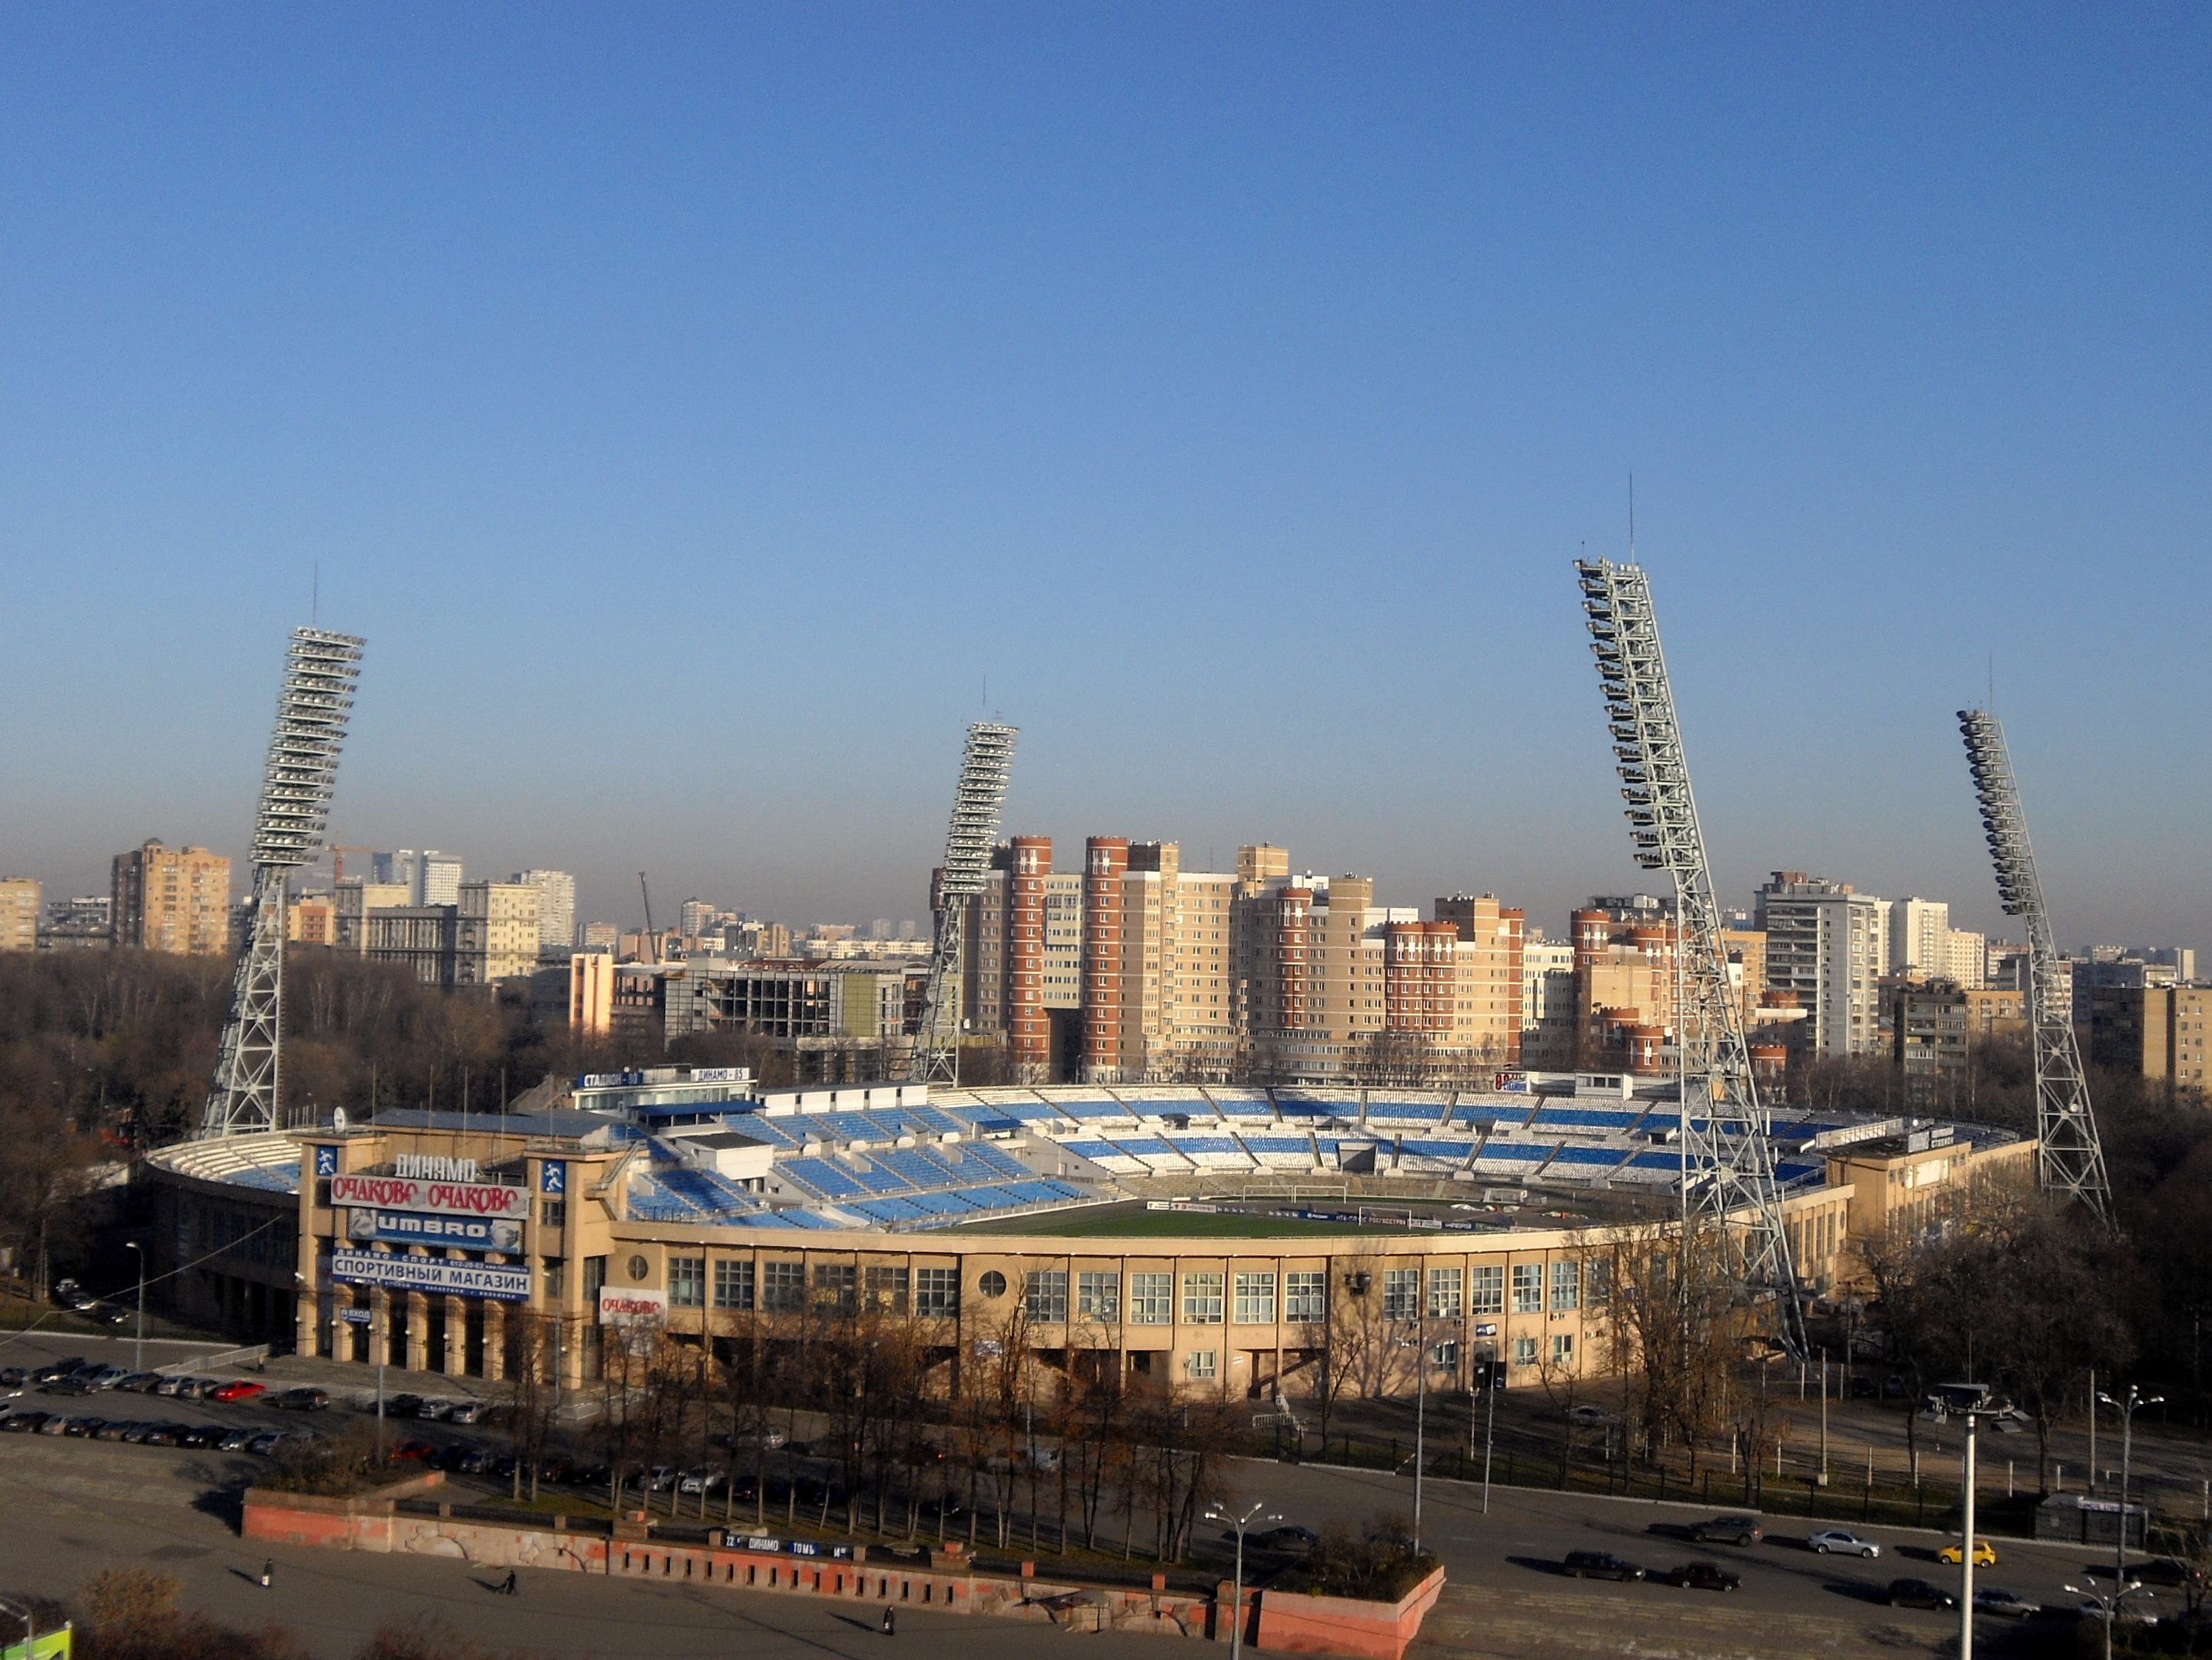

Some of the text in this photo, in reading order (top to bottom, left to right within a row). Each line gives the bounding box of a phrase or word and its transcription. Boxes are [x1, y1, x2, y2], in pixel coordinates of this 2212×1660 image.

[584, 1073, 621, 1086] СТАДИОН
[698, 1070, 727, 1081] ДИНАМО
[394, 1154, 476, 1183] ДИНАМО
[337, 1249, 390, 1259] ДИНАМО
[401, 1255, 444, 1265] СПОРТ
[334, 1259, 527, 1291] СПОРТИВНЫЙ МАГАЗИН
[348, 1309, 370, 1319] ВХОД
[748, 1538, 780, 1552] ДИНАМО
[793, 1542, 815, 1555] ТОМЬ
